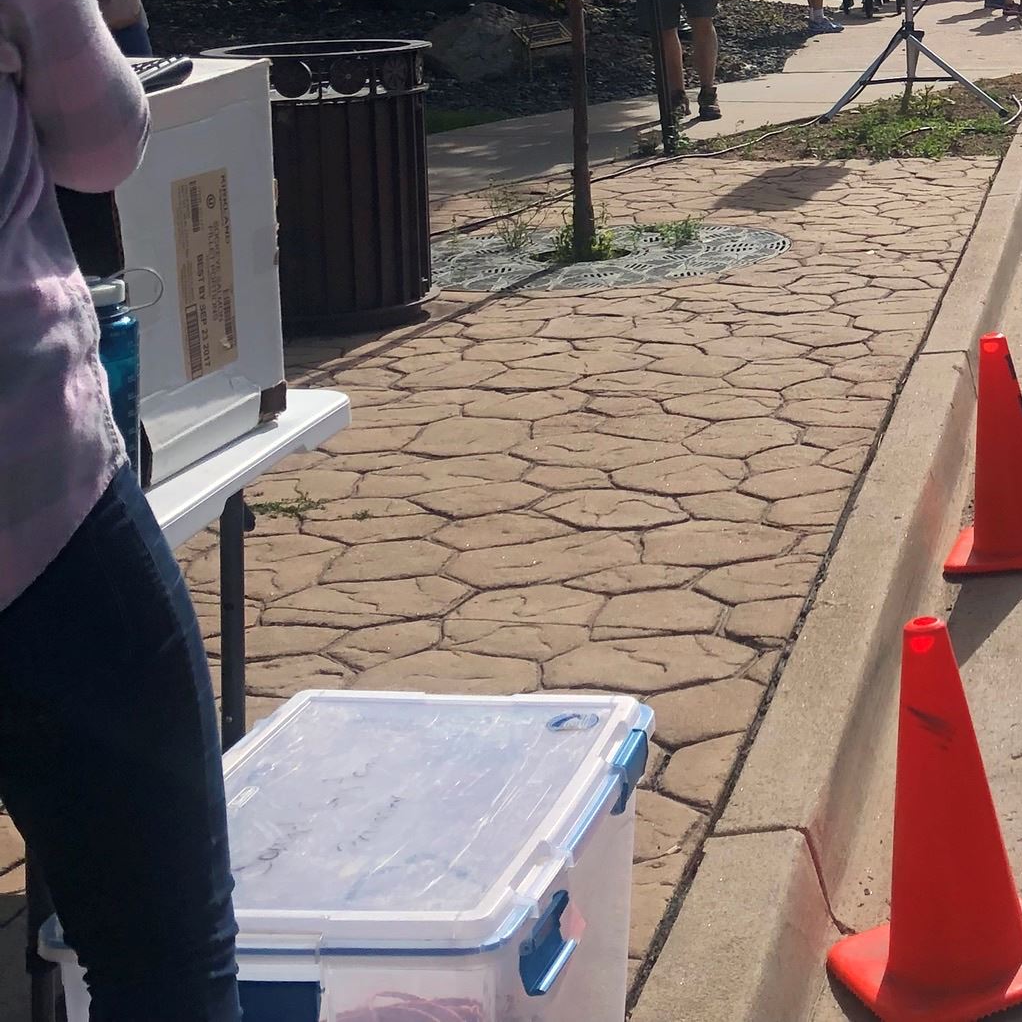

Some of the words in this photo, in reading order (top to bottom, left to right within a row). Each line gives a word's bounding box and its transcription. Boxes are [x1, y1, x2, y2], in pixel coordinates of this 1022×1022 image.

[196, 254, 206, 283] BEST
[199, 285, 206, 300] BY
[200, 304, 209, 326] SEP
[202, 343, 211, 367] 2017
